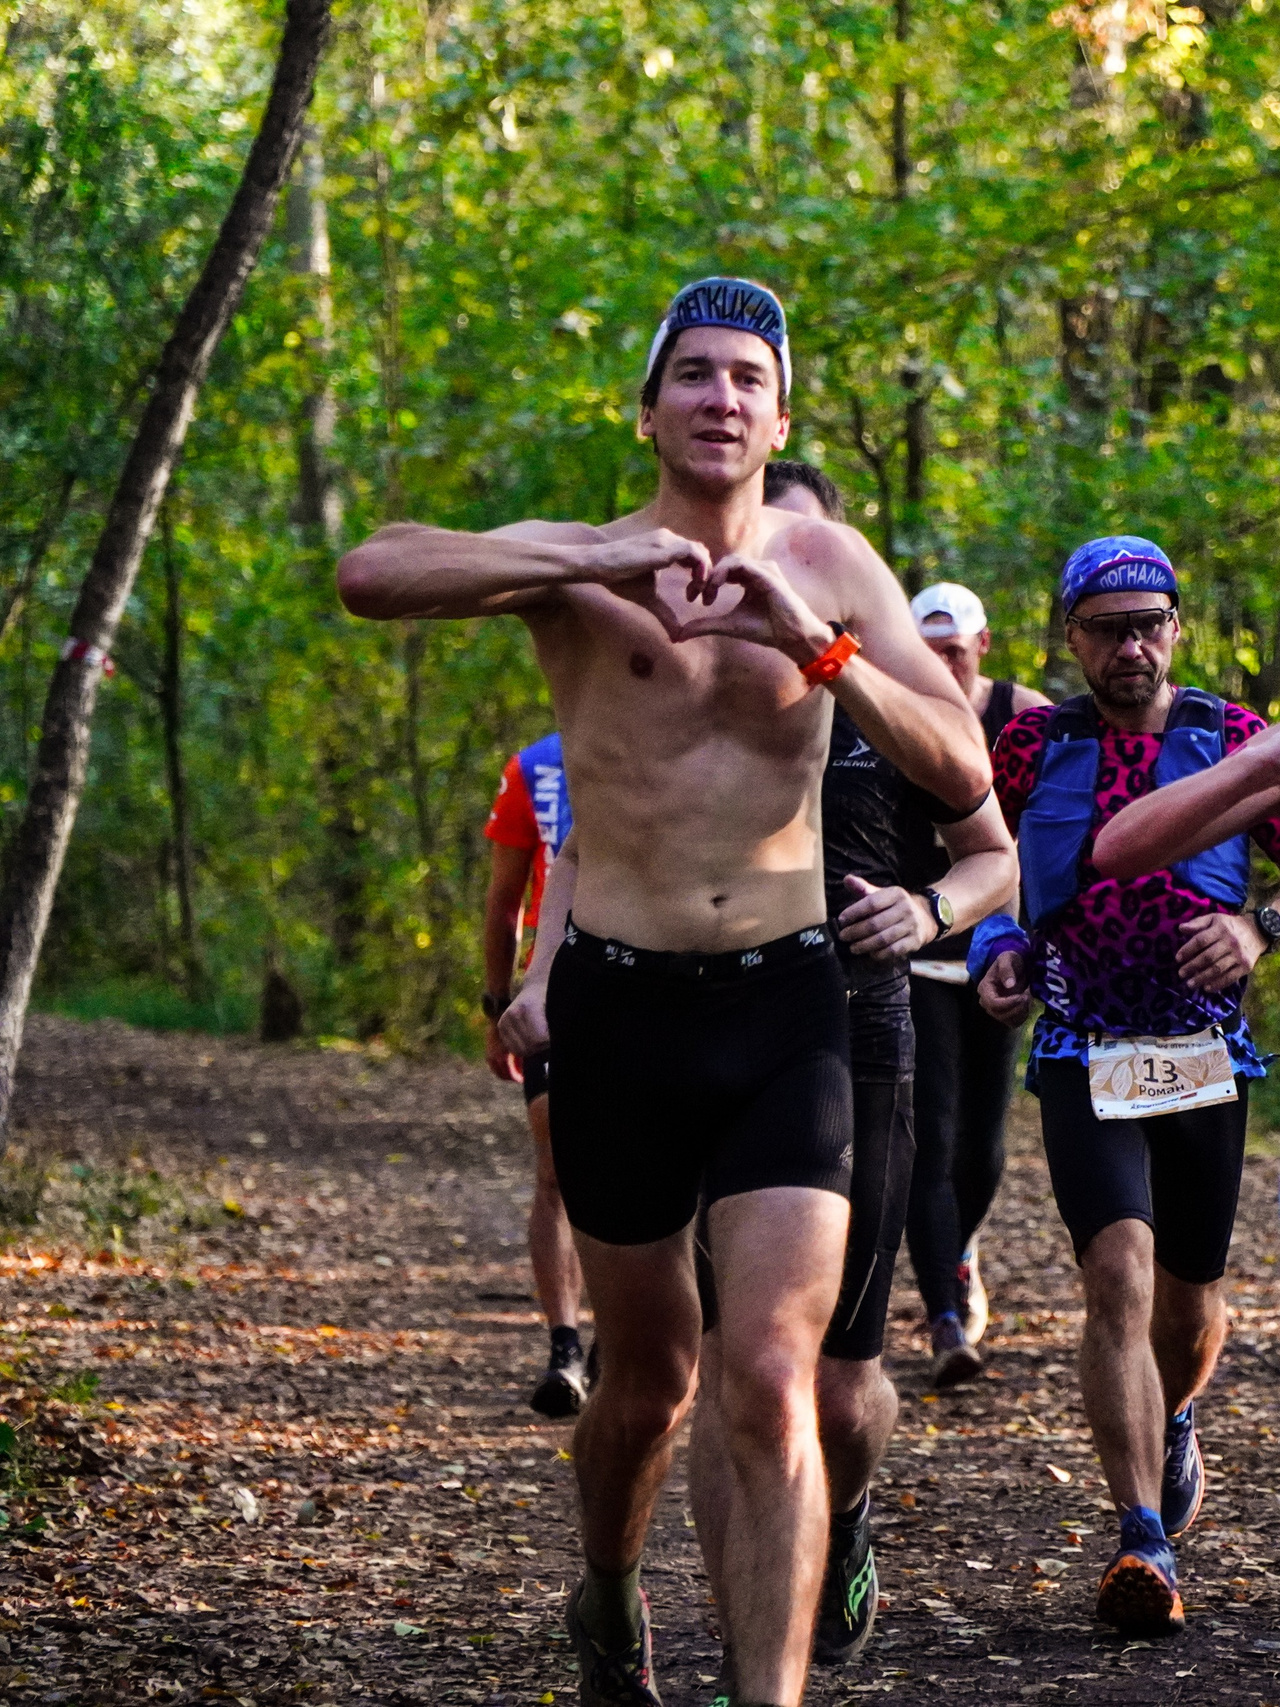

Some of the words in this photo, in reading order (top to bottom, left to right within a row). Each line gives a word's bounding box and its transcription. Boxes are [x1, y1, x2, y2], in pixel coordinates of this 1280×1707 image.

[832, 759, 877, 768] DEMIX
[1142, 1058, 1179, 1084] 13
[1139, 1084, 1185, 1097] Роман
